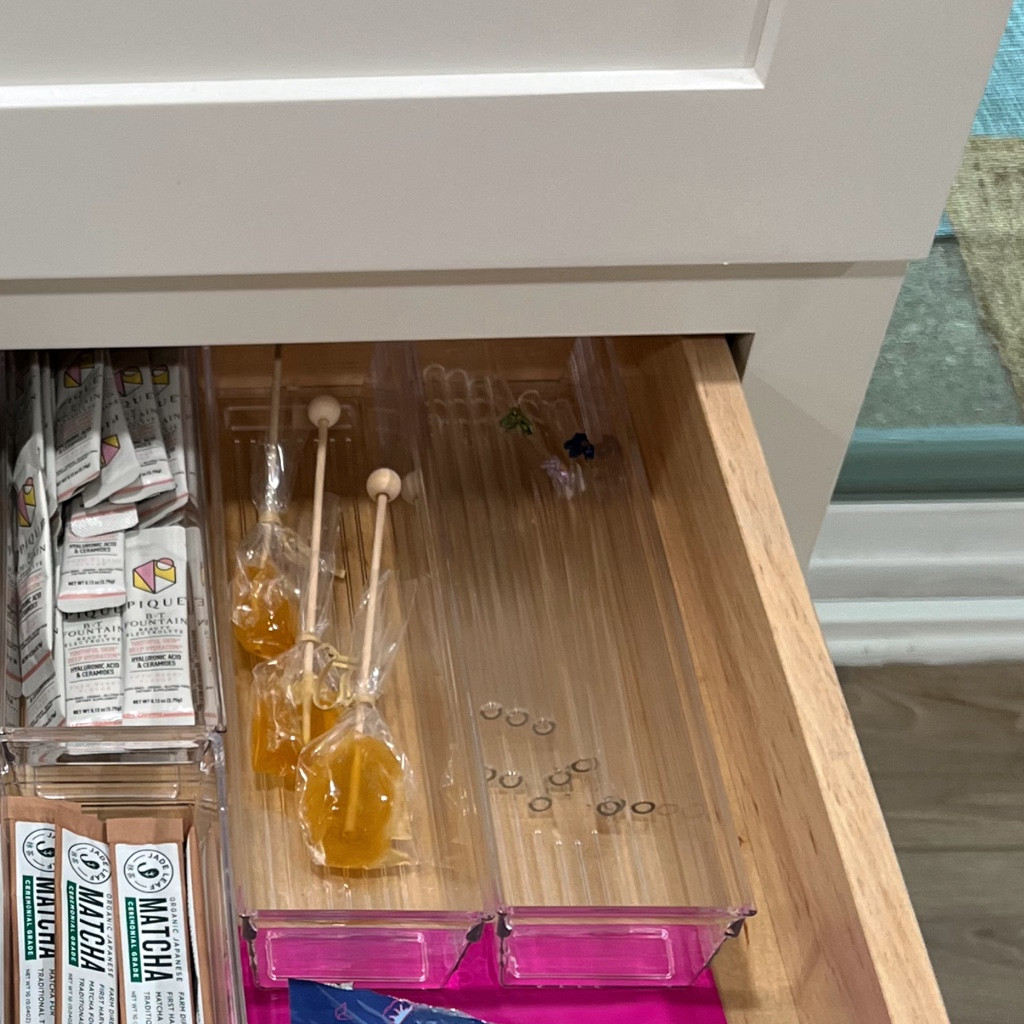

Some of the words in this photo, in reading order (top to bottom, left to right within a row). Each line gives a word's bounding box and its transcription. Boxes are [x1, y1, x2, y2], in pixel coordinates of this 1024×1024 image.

[128, 597, 186, 609] PIQUE
[131, 655, 166, 663] HYALURONIC
[148, 853, 170, 870] JADE
[149, 874, 170, 890] LEAF
[68, 885, 76, 932] CEREMONIAL
[169, 897, 179, 934] ORGANIC
[78, 885, 106, 973] MATCHA
[128, 901, 137, 948] CEREMONIAL
[139, 898, 173, 981] MATCHA
[132, 951, 140, 978] GRADE
[173, 938, 183, 982] JAPANESE
[166, 992, 174, 1011] FIRST
[178, 992, 186, 1012] FARM
